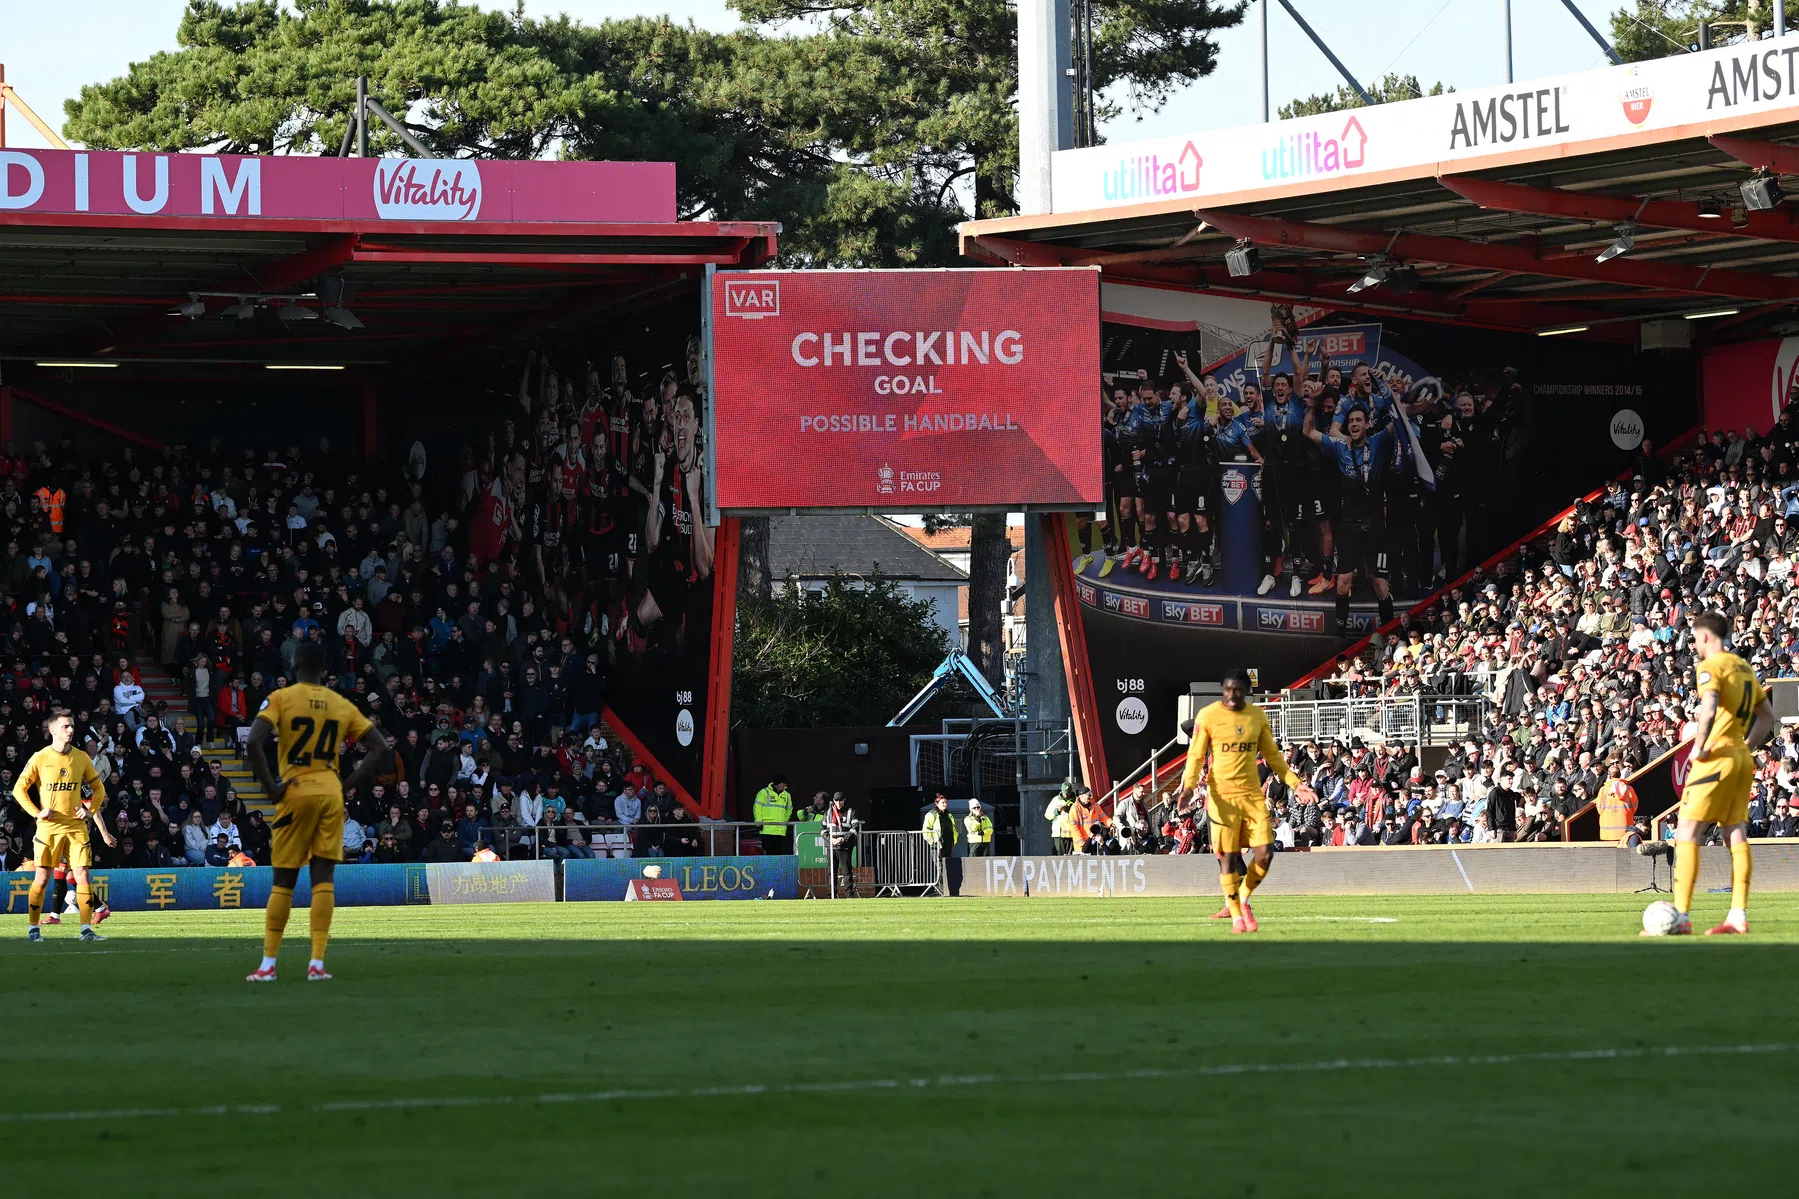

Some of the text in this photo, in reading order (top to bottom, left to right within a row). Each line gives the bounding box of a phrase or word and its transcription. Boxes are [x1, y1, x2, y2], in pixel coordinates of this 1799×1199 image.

[1624, 87, 1650, 99] AMSTEL
[1630, 102, 1644, 111] BIER
[1450, 87, 1570, 150] AMSTEL
[1262, 131, 1340, 181] utilita
[1104, 155, 1178, 200] utilita
[380, 160, 477, 220] Vitality
[731, 289, 775, 308] VAR
[791, 330, 1024, 367] CHECKING
[1326, 334, 1361, 353] BET
[874, 375, 943, 395] GOAL
[1533, 384, 1643, 396] CHAMPIONSHIP WINNERS 2014/15
[800, 412, 1018, 433] POSSIBLE HANDBALL
[1613, 420, 1641, 438] Vitality
[900, 470, 941, 481] Emirates
[900, 481, 941, 492] FA CUP
[1377, 553, 1387, 569] 11
[1081, 586, 1095, 602] BET
[1105, 594, 1146, 615] sky BET
[1165, 605, 1221, 622] sky BET
[1261, 612, 1321, 629] sky BET
[1346, 615, 1369, 631] sky
[1117, 679, 1145, 693] bj88
[309, 699, 328, 711] TOTI
[676, 690, 692, 705] bj88
[1735, 680, 1753, 727] 4
[1119, 707, 1145, 723] Vitality
[287, 716, 339, 767] 24
[1222, 742, 1257, 753] DEBET
[45, 782, 78, 792] DEBET
[451, 872, 529, 895] 力昂地产
[682, 865, 755, 892] LEOS
[985, 856, 1146, 894] IFX PAYMENTS
